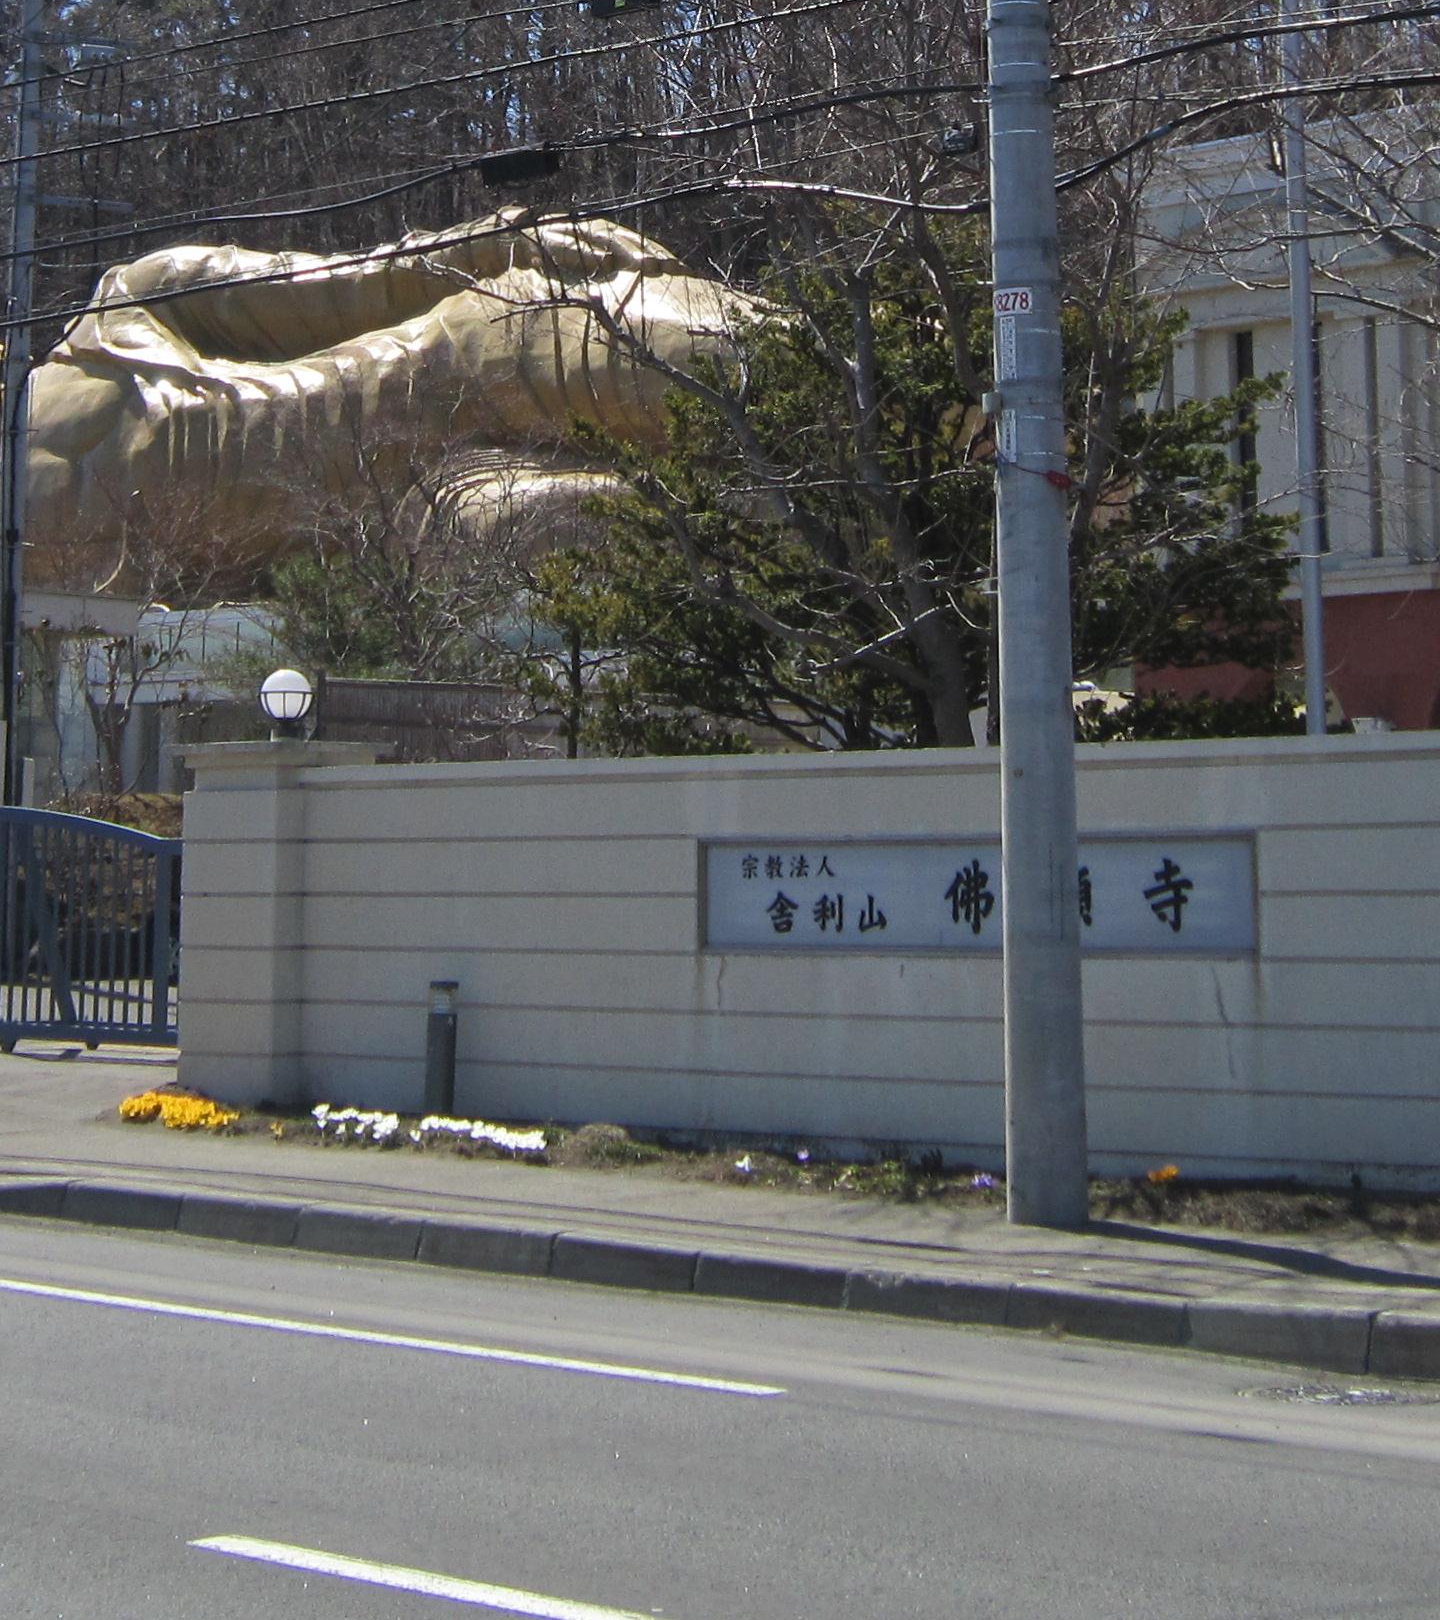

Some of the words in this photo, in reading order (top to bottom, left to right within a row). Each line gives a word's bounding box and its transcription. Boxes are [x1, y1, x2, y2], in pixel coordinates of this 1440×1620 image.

[741, 854, 835, 879] 宗教法人
[944, 858, 1194, 935] 佛寺
